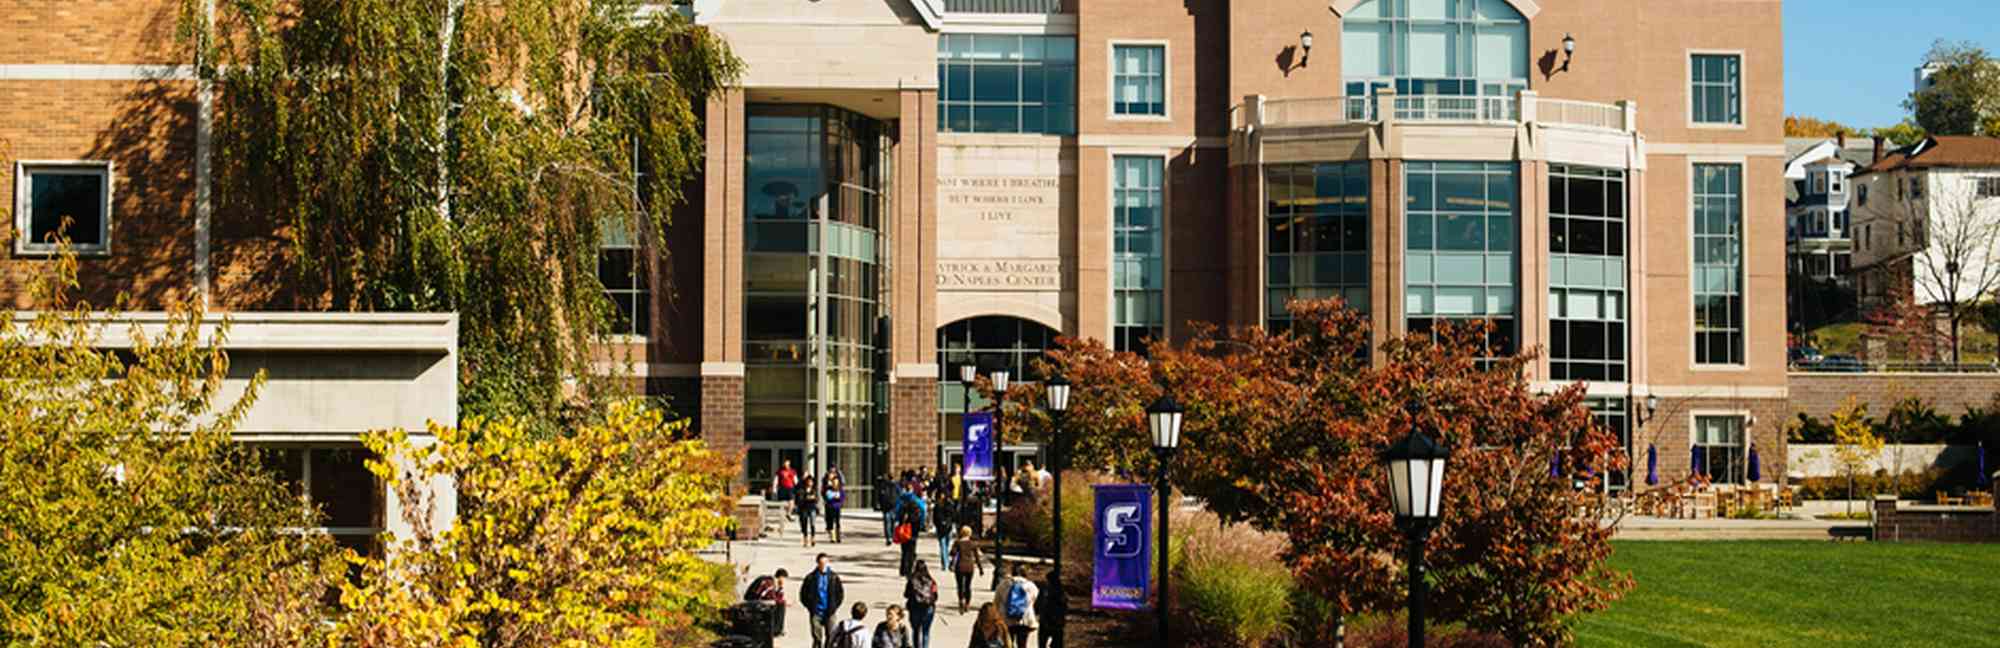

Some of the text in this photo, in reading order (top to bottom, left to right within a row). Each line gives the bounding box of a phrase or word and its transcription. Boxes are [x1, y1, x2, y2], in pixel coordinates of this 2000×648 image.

[960, 179, 999, 187] WHERE
[949, 195, 969, 203] BUT
[973, 195, 1008, 203] WHERE
[988, 212, 1011, 220] LIVE
[938, 263, 979, 273] ATRICK
[1006, 274, 1056, 285] CENTER
[1103, 502, 1142, 557] S
